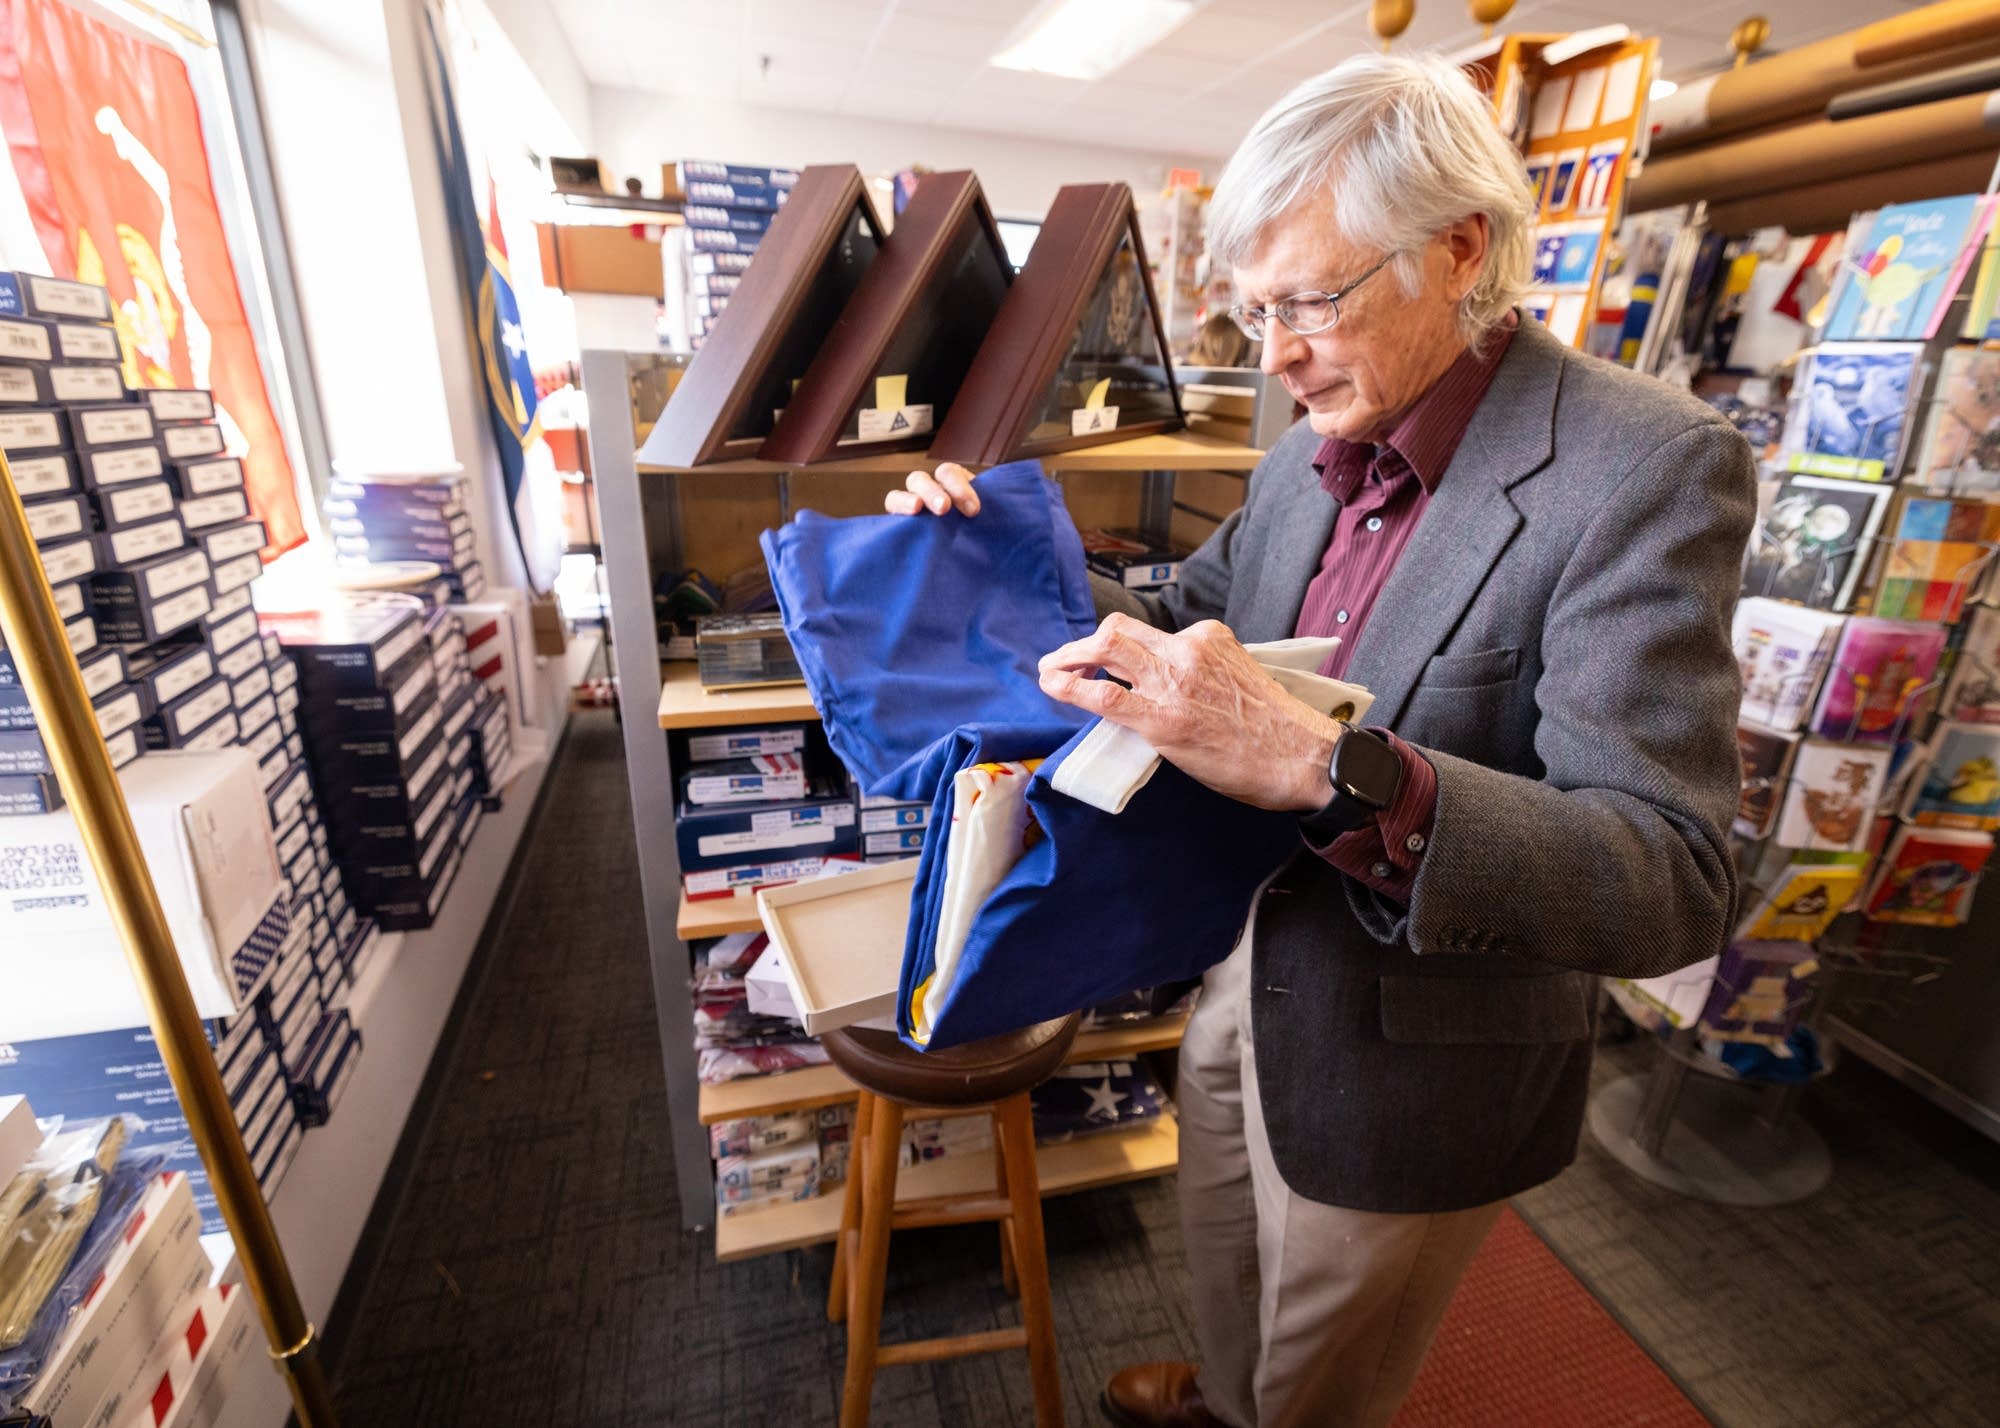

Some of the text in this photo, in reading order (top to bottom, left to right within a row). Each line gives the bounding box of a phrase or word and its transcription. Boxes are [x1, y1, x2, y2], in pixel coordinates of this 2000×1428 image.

[4, 843, 77, 858] TO FLAG
[52, 875, 84, 888] CUT
